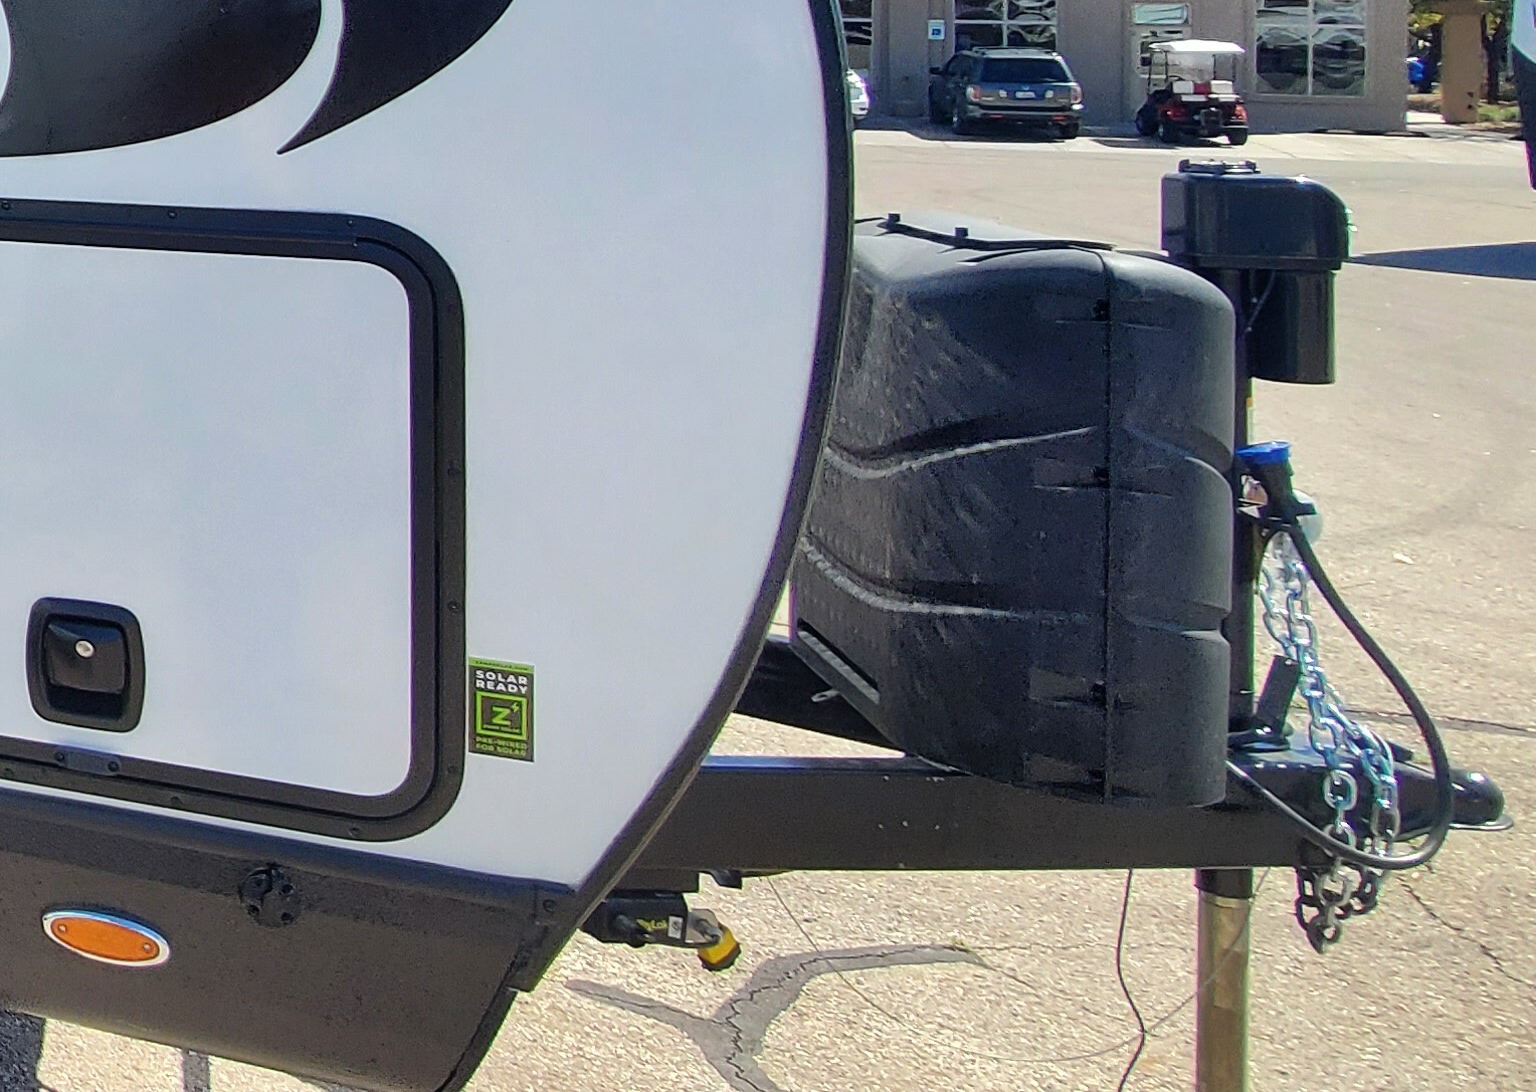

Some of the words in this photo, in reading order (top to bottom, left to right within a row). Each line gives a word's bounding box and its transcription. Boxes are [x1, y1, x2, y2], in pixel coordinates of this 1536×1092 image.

[475, 670, 528, 685] SOLAR
[475, 679, 528, 694] READY
[475, 736, 527, 750] PRE-WIRED
[475, 743, 495, 752] FOR
[496, 745, 526, 757] SOLAR
